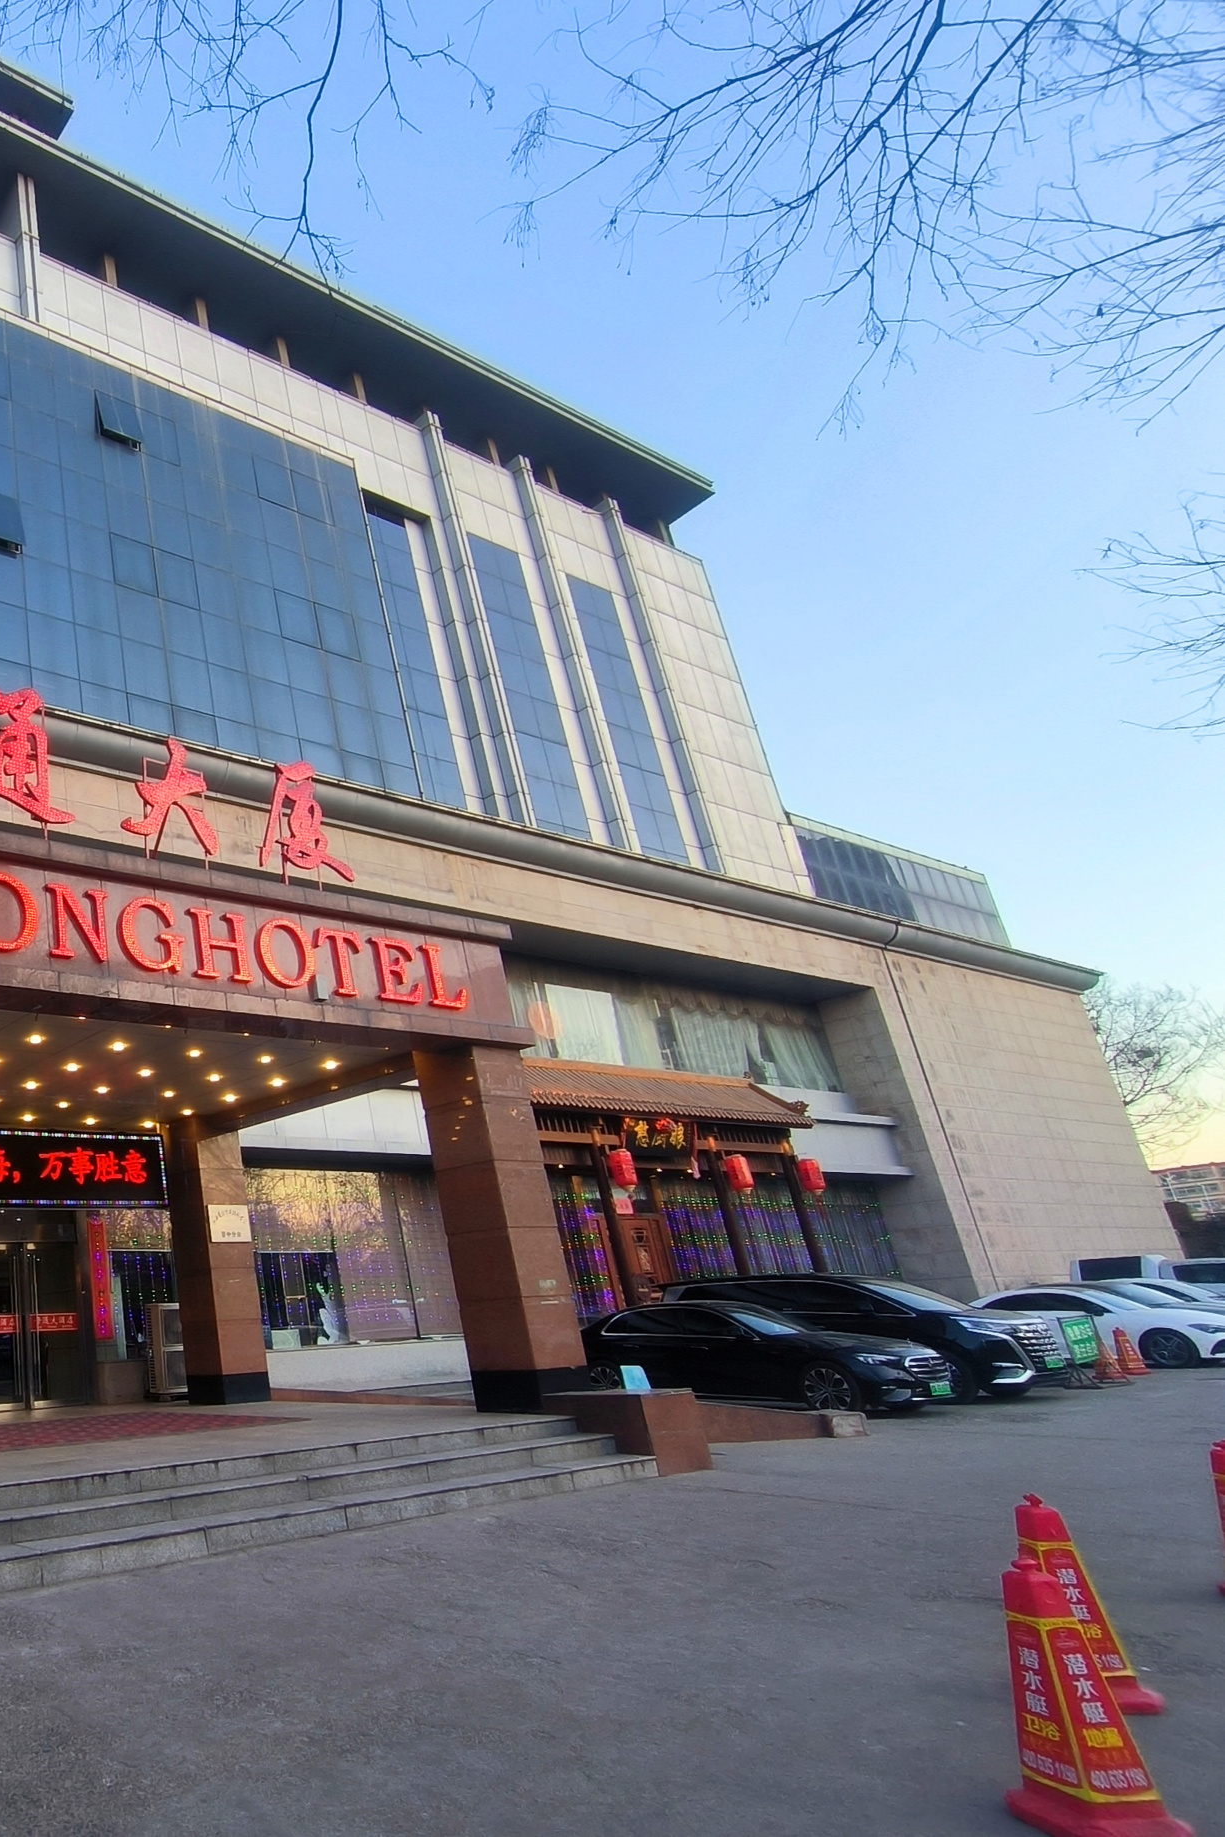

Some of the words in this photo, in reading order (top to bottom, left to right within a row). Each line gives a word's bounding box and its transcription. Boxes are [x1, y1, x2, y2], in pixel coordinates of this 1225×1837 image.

[1083, 1622, 1103, 1639] 浴
[1018, 1645, 1050, 1716] 潜水艇
[1062, 1653, 1110, 1723] 潜水艇
[1021, 1712, 1061, 1741] 卫浴
